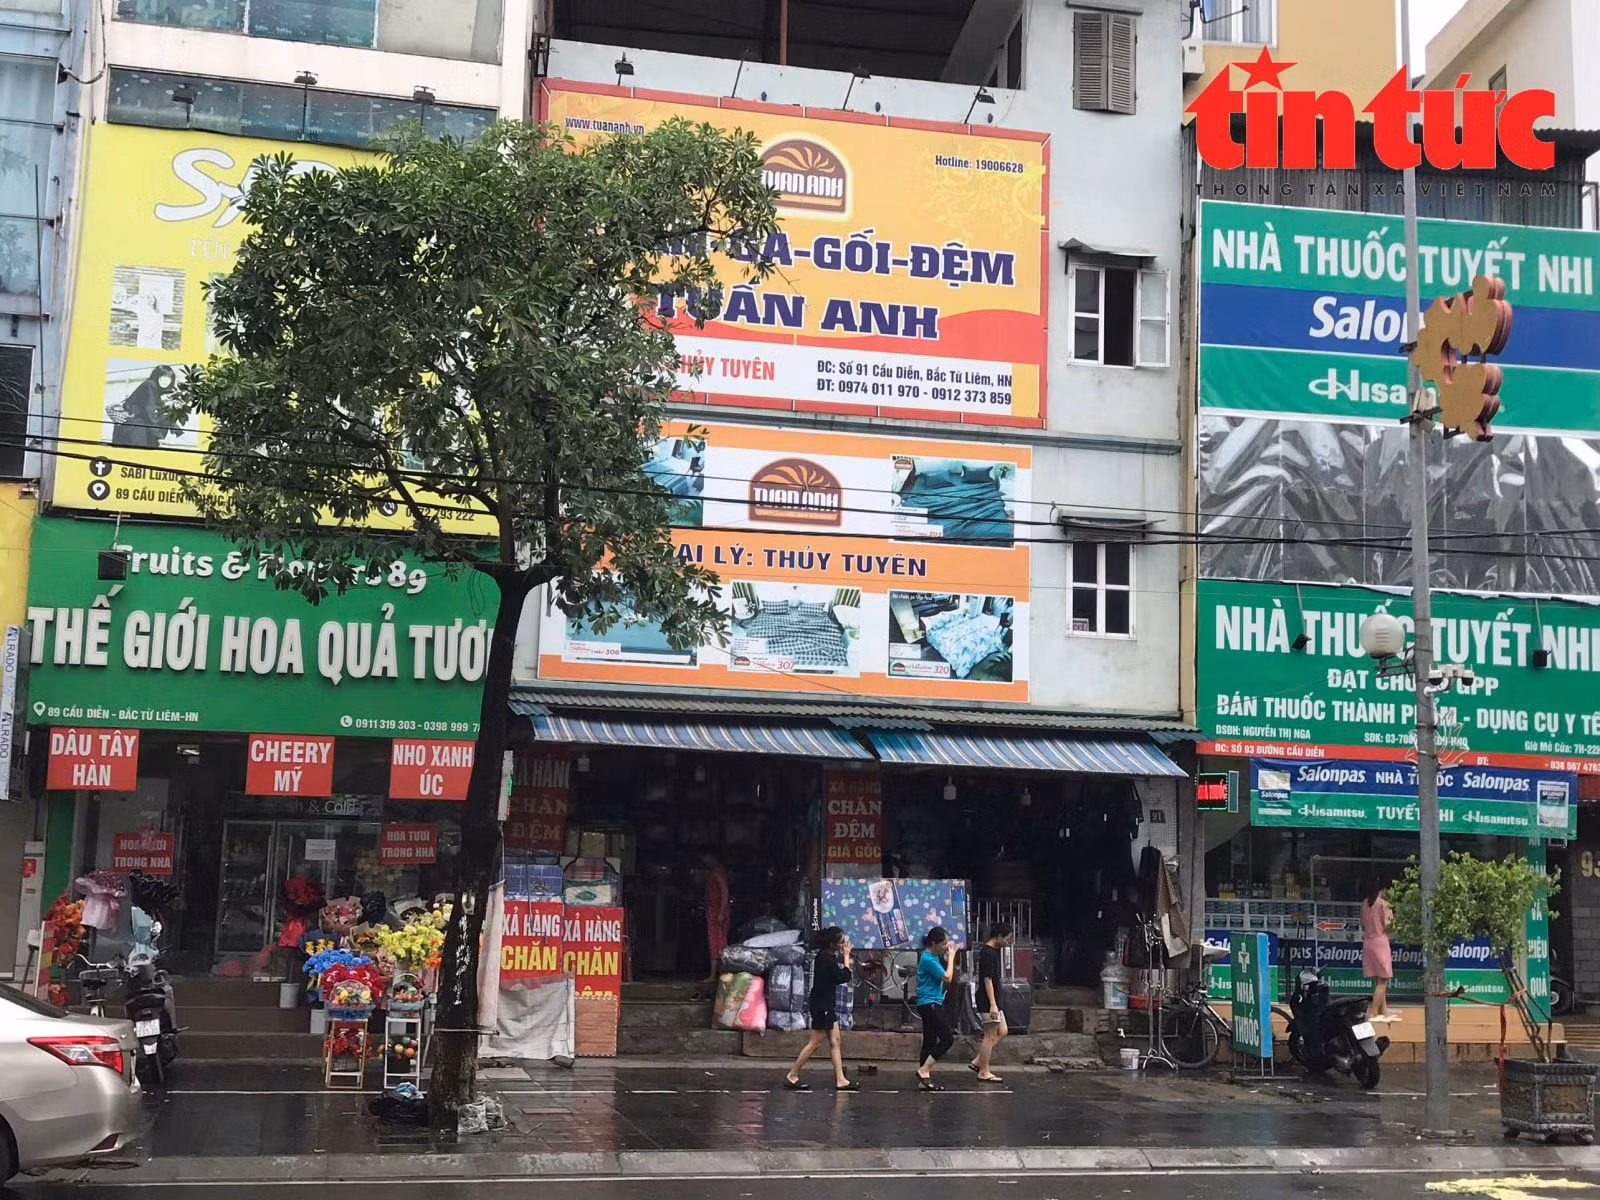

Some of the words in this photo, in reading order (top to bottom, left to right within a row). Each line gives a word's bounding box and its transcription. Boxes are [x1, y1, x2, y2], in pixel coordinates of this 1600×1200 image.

[565, 117, 645, 135] www.tuananh.vn
[935, 154, 972, 169] Hotline:
[976, 159, 1024, 174] 19006628
[806, 174, 843, 198] ANH
[1212, 221, 1282, 272] NHÀ
[1293, 225, 1407, 282] THUỐC
[1417, 236, 1526, 290] TUYẾT
[1537, 254, 1593, 295] NHI
[820, 298, 939, 339] ANH
[675, 349, 715, 376] HỦY
[720, 356, 775, 381] TUYÊN
[817, 359, 837, 374] ĐC:
[838, 360, 853, 375] Số
[856, 363, 869, 376] 91
[926, 367, 947, 383] Bắc
[950, 369, 963, 384] Từ
[965, 371, 994, 387] Liêm,
[997, 374, 1012, 387] HN
[817, 378, 835, 392] ĐT:
[838, 379, 868, 394] 0974
[872, 383, 893, 396] 011
[897, 385, 920, 398] 970
[931, 387, 961, 401] 0912
[964, 391, 987, 404] 373
[989, 393, 1012, 405] 859
[115, 487, 130, 501] 89
[455, 511, 475, 521] 222
[220, 550, 250, 580] &
[387, 560, 427, 595] 89
[714, 543, 753, 565] LÝ:
[763, 546, 831, 571] THỦY
[842, 553, 927, 577] TUYÊN
[27, 583, 125, 667] THẾ
[122, 596, 211, 672] GIỚI
[219, 615, 305, 676] HOA
[317, 602, 399, 686] QUẢ
[1215, 598, 1291, 654] NHÀ
[1301, 598, 1415, 661] THUC
[1430, 607, 1532, 668] TUYẾT
[1543, 624, 1600, 673] NHI
[777, 660, 796, 670] 307
[934, 665, 950, 675] 320
[1327, 668, 1369, 693] ĐẠT
[47, 706, 60, 717] 89
[118, 706, 138, 721] BẮC
[140, 707, 155, 722] TỪ
[155, 709, 199, 723] LIÊM-HN
[355, 718, 378, 729] 0911
[379, 719, 396, 730] 319
[397, 720, 417, 731] 303
[423, 721, 448, 732] 0398
[450, 722, 469, 733] 999
[1216, 691, 1258, 717] BÁN
[1263, 691, 1326, 721] THUỐC
[1332, 697, 1396, 725] THÀNH
[1476, 708, 1528, 734] DỤNG
[1534, 711, 1559, 738] CỤ
[1564, 713, 1576, 735] Y
[51, 728, 92, 757] DÂU
[98, 729, 137, 757] TÂY
[1278, 727, 1292, 741] THỊ
[1293, 728, 1311, 740] NGA
[250, 739, 332, 764] CHEERY
[393, 744, 427, 767] NHO
[430, 745, 473, 768] XANH
[72, 758, 112, 787] HÀN
[273, 765, 303, 793] MỸ
[419, 769, 444, 796] ÚC
[1296, 765, 1368, 785] Salonpas
[1375, 769, 1404, 784] NHÀ
[1462, 771, 1530, 793] Salonpas
[827, 796, 883, 816] CHĂN
[1260, 790, 1289, 799] Salonpas
[1297, 803, 1367, 819] Hisamitsu
[1462, 809, 1529, 826] Hisamitsu
[833, 819, 876, 842] ĐỆM
[113, 856, 148, 868] TRONG
[382, 846, 413, 858] TRONG
[502, 906, 520, 937] XẢ
[523, 908, 561, 938] HÀNG
[563, 911, 582, 943] XẢ
[584, 912, 622, 943] HÀNG
[500, 942, 558, 971] CHĂN
[563, 946, 619, 977] CHĂN
[1236, 979, 1255, 1005] NHÀ
[1530, 970, 1548, 999] QUẢ
[1234, 1008, 1260, 1048] THUỐC
